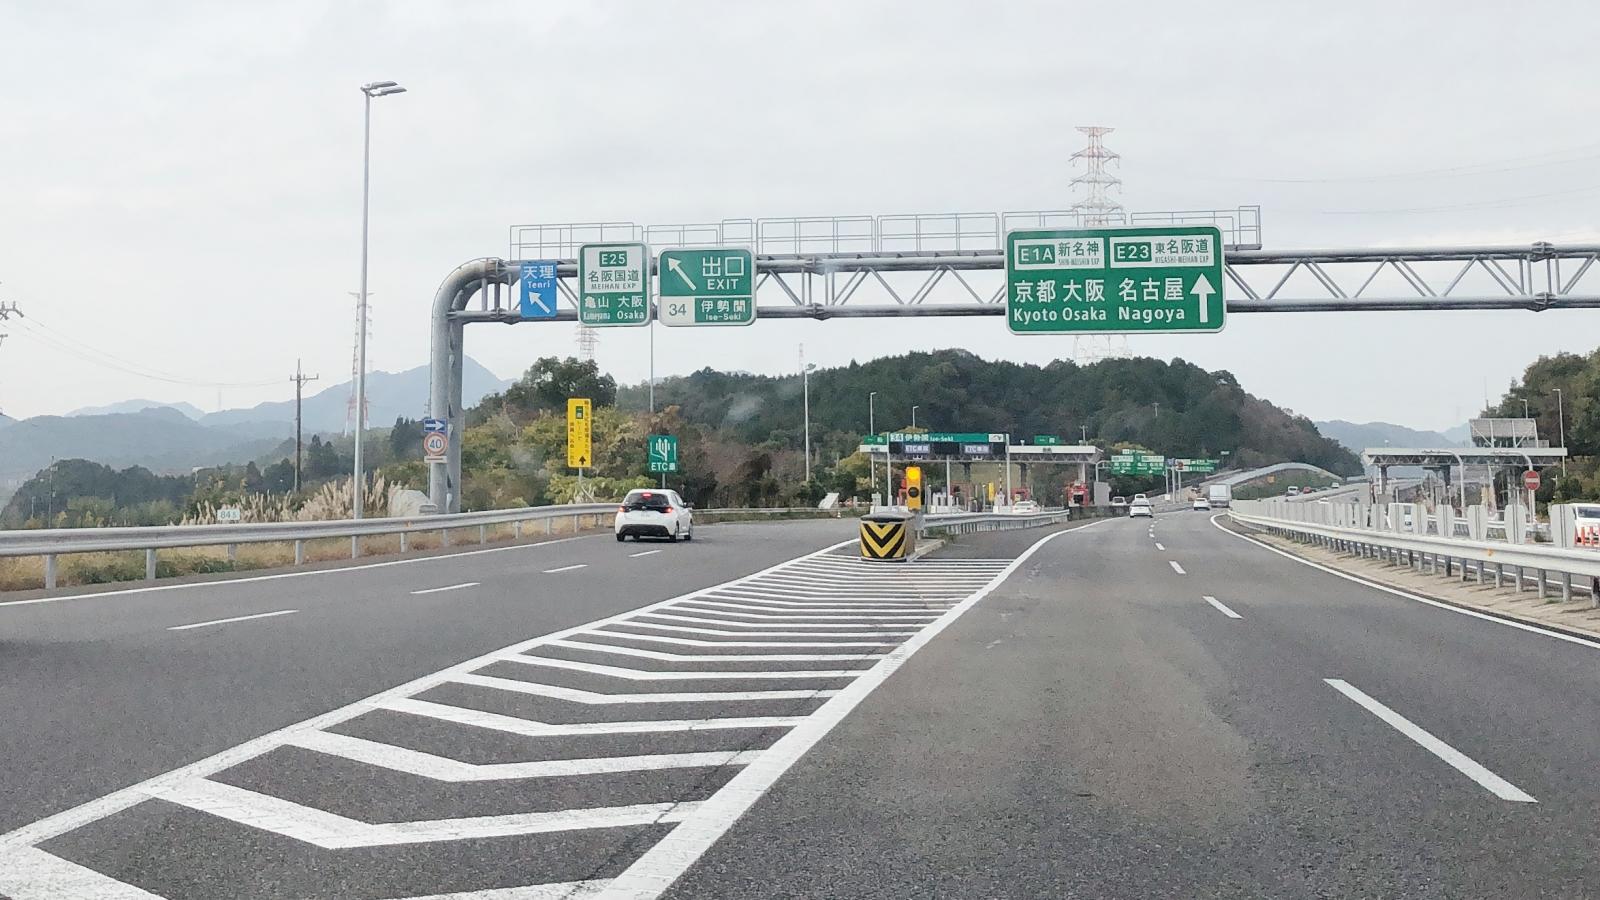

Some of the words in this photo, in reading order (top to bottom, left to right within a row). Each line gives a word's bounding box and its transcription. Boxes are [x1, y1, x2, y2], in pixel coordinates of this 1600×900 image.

[1058, 240, 1100, 257] 新名神
[1116, 245, 1149, 259] E23
[1155, 238, 1209, 254] 東名阪道
[601, 253, 626, 265] E25
[1020, 247, 1053, 262] E1A
[523, 265, 555, 280] 天理
[702, 256, 745, 277] 出口
[588, 269, 640, 282] 名阪国道
[527, 280, 551, 289] Tenri
[591, 282, 620, 290] MEIHAN
[707, 278, 739, 290] EXIT
[1014, 279, 1056, 303] 京都
[1062, 278, 1106, 303] 大阪
[1118, 277, 1185, 302] 名古屋
[584, 295, 609, 309] 亀山
[617, 295, 644, 308] 大阪
[701, 299, 746, 313] 伊勢関
[617, 310, 645, 320] Osaka
[668, 303, 687, 316] 34
[705, 312, 741, 320] Ise-Seki
[1013, 307, 1058, 325] Kyoto
[1062, 306, 1107, 322] Osaka
[1118, 306, 1185, 324] Nagoya
[429, 439, 442, 449] 40
